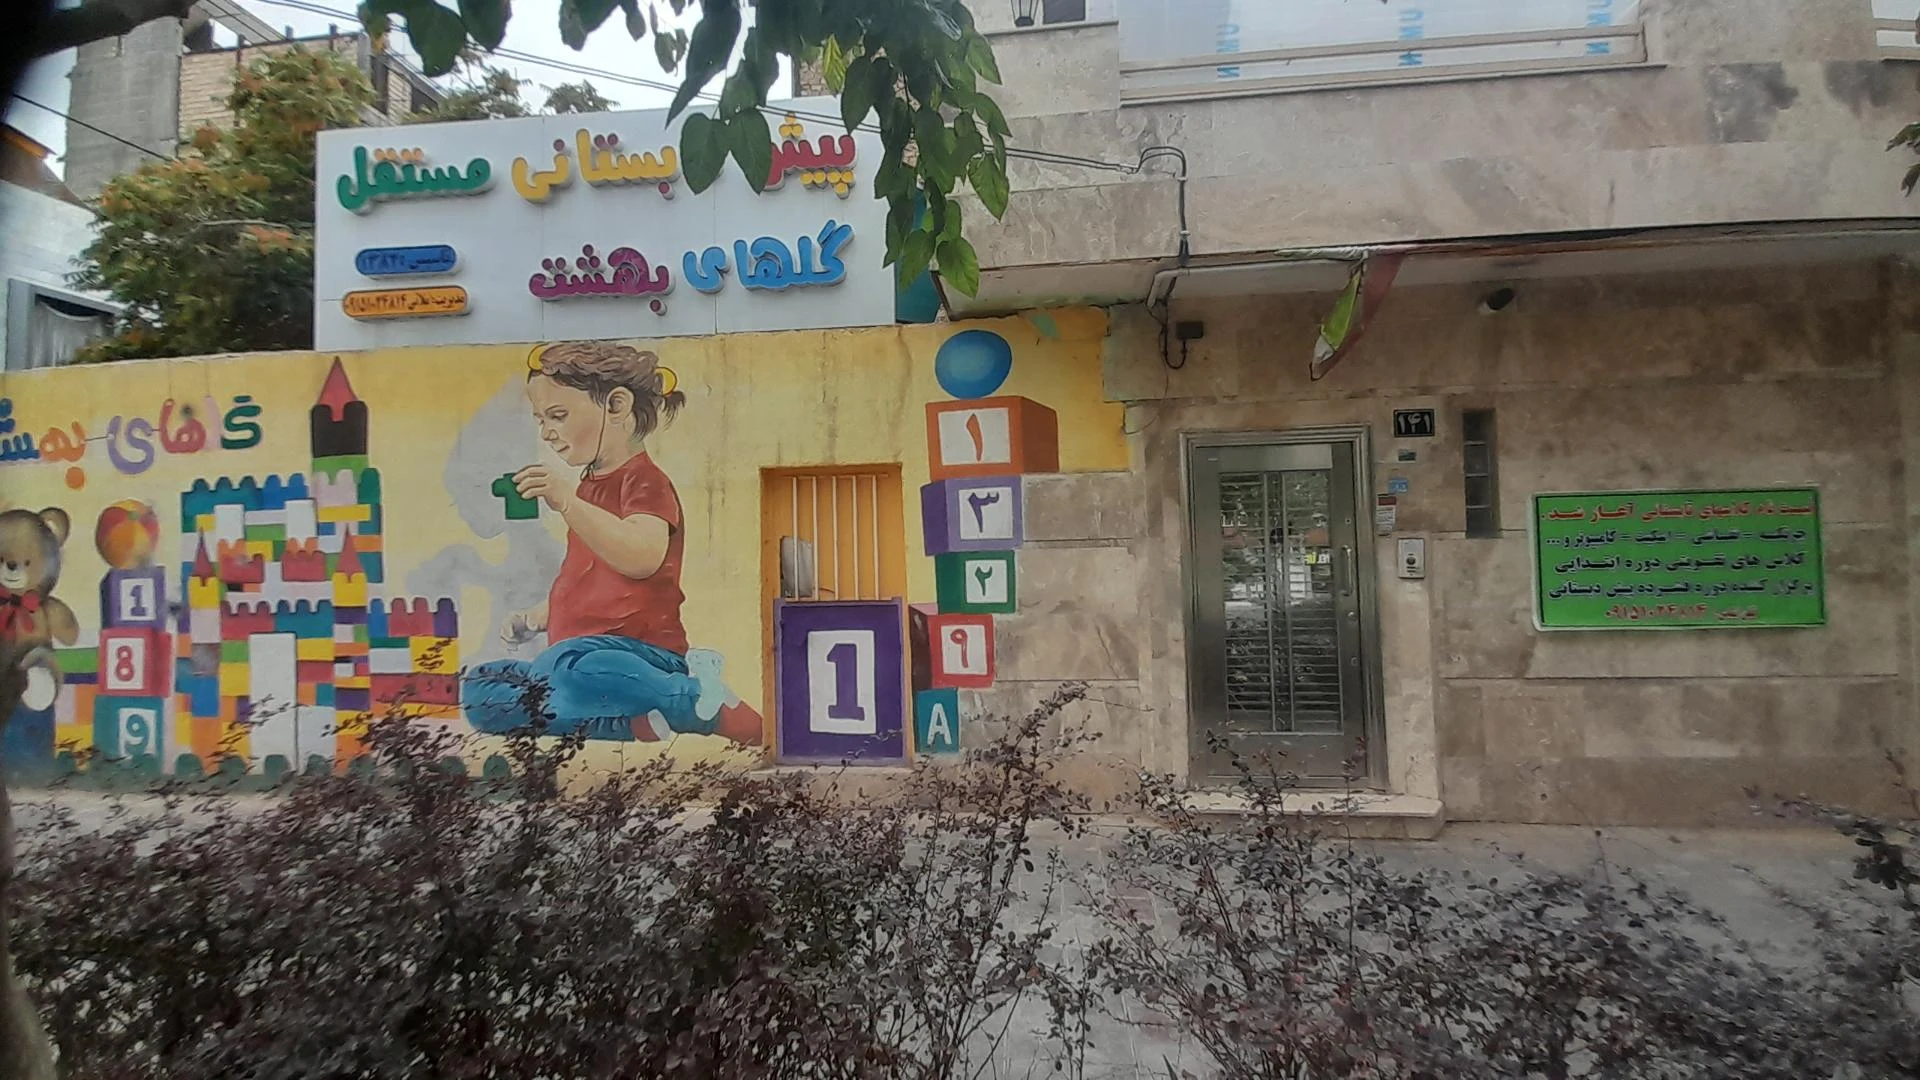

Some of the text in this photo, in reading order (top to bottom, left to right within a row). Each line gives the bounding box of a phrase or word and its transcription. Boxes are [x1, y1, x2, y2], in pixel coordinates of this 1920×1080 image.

[337, 146, 491, 215] مستقل
[511, 128, 678, 202] بستانی
[528, 219, 855, 316] گلهای بهشت
[0, 398, 87, 489] بهش
[968, 491, 999, 533] ۳
[128, 588, 147, 626] 1
[974, 565, 993, 597] ۲
[115, 645, 135, 681] 8
[826, 643, 866, 721] 1
[926, 702, 952, 746] A
